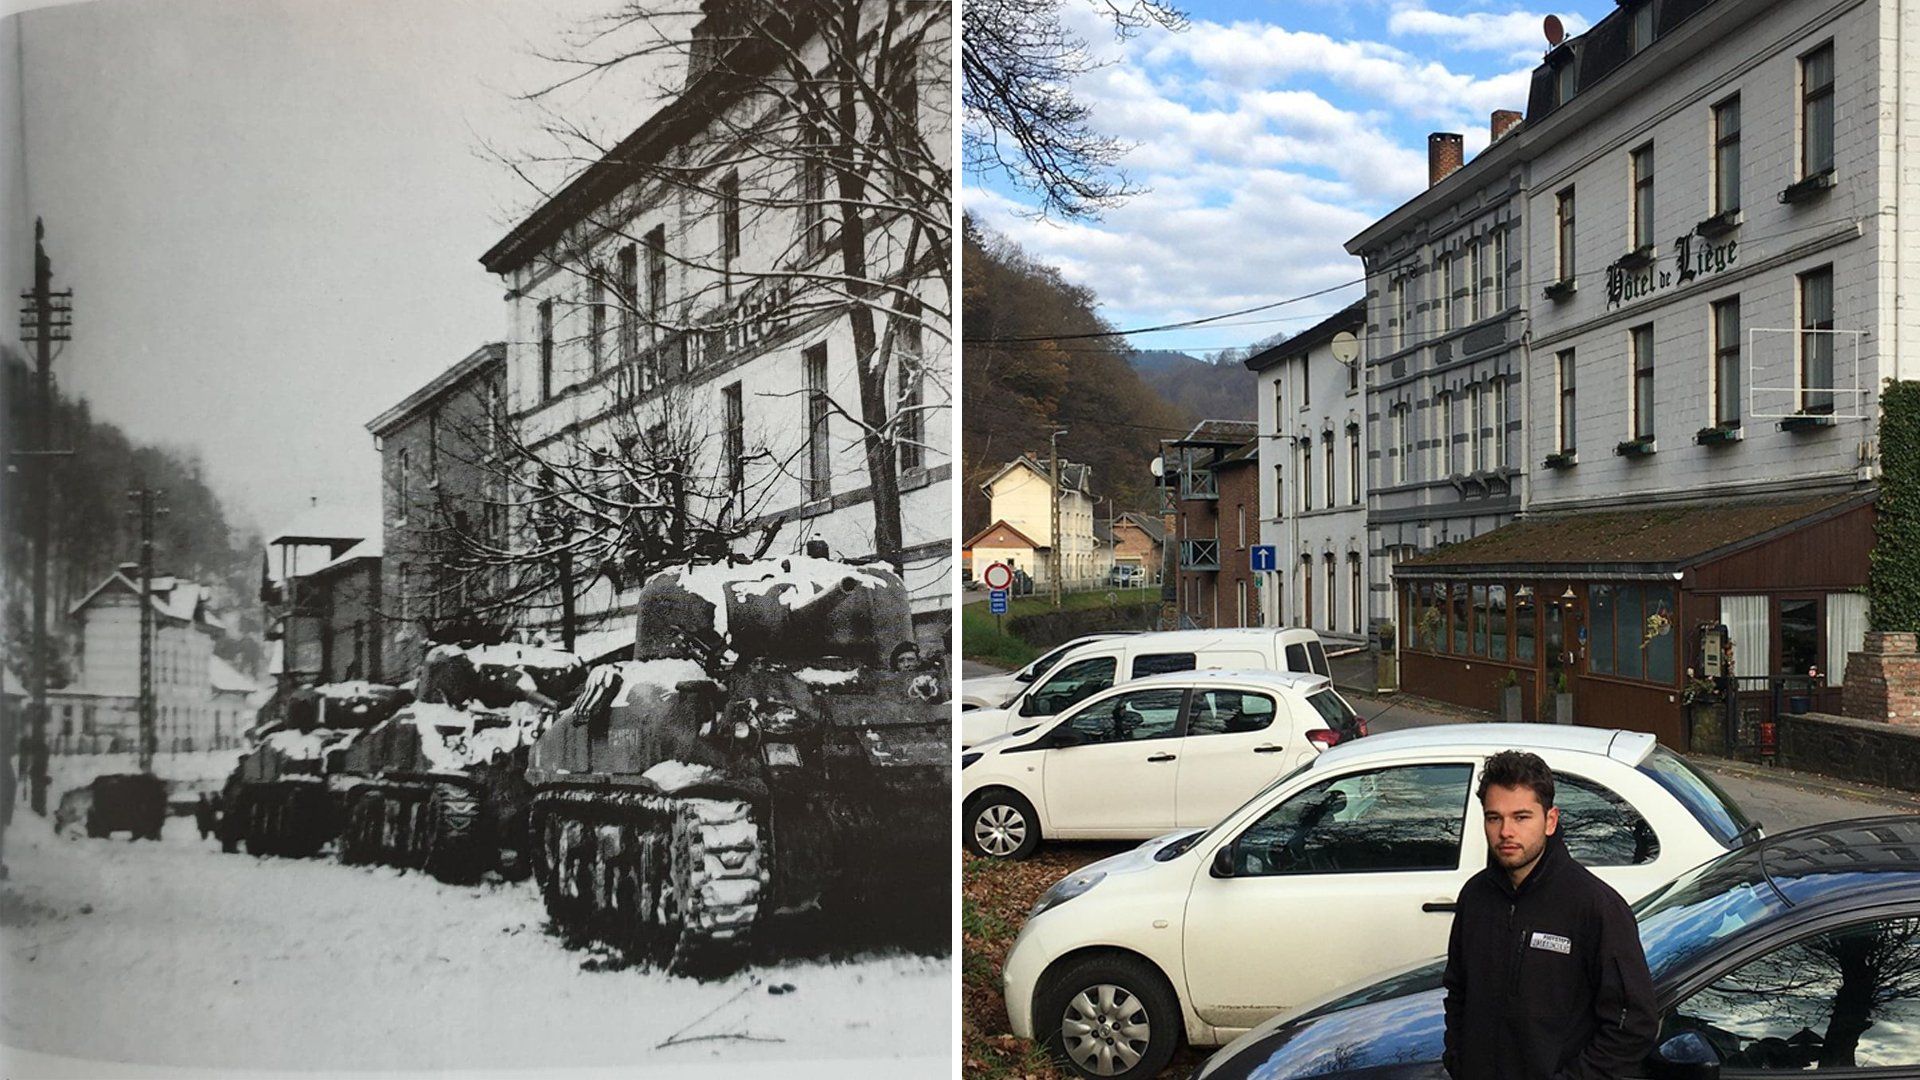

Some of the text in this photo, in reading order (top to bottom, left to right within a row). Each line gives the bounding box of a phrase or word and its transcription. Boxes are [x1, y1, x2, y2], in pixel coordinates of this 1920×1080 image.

[1606, 232, 1738, 311] Hôtel de Liège
